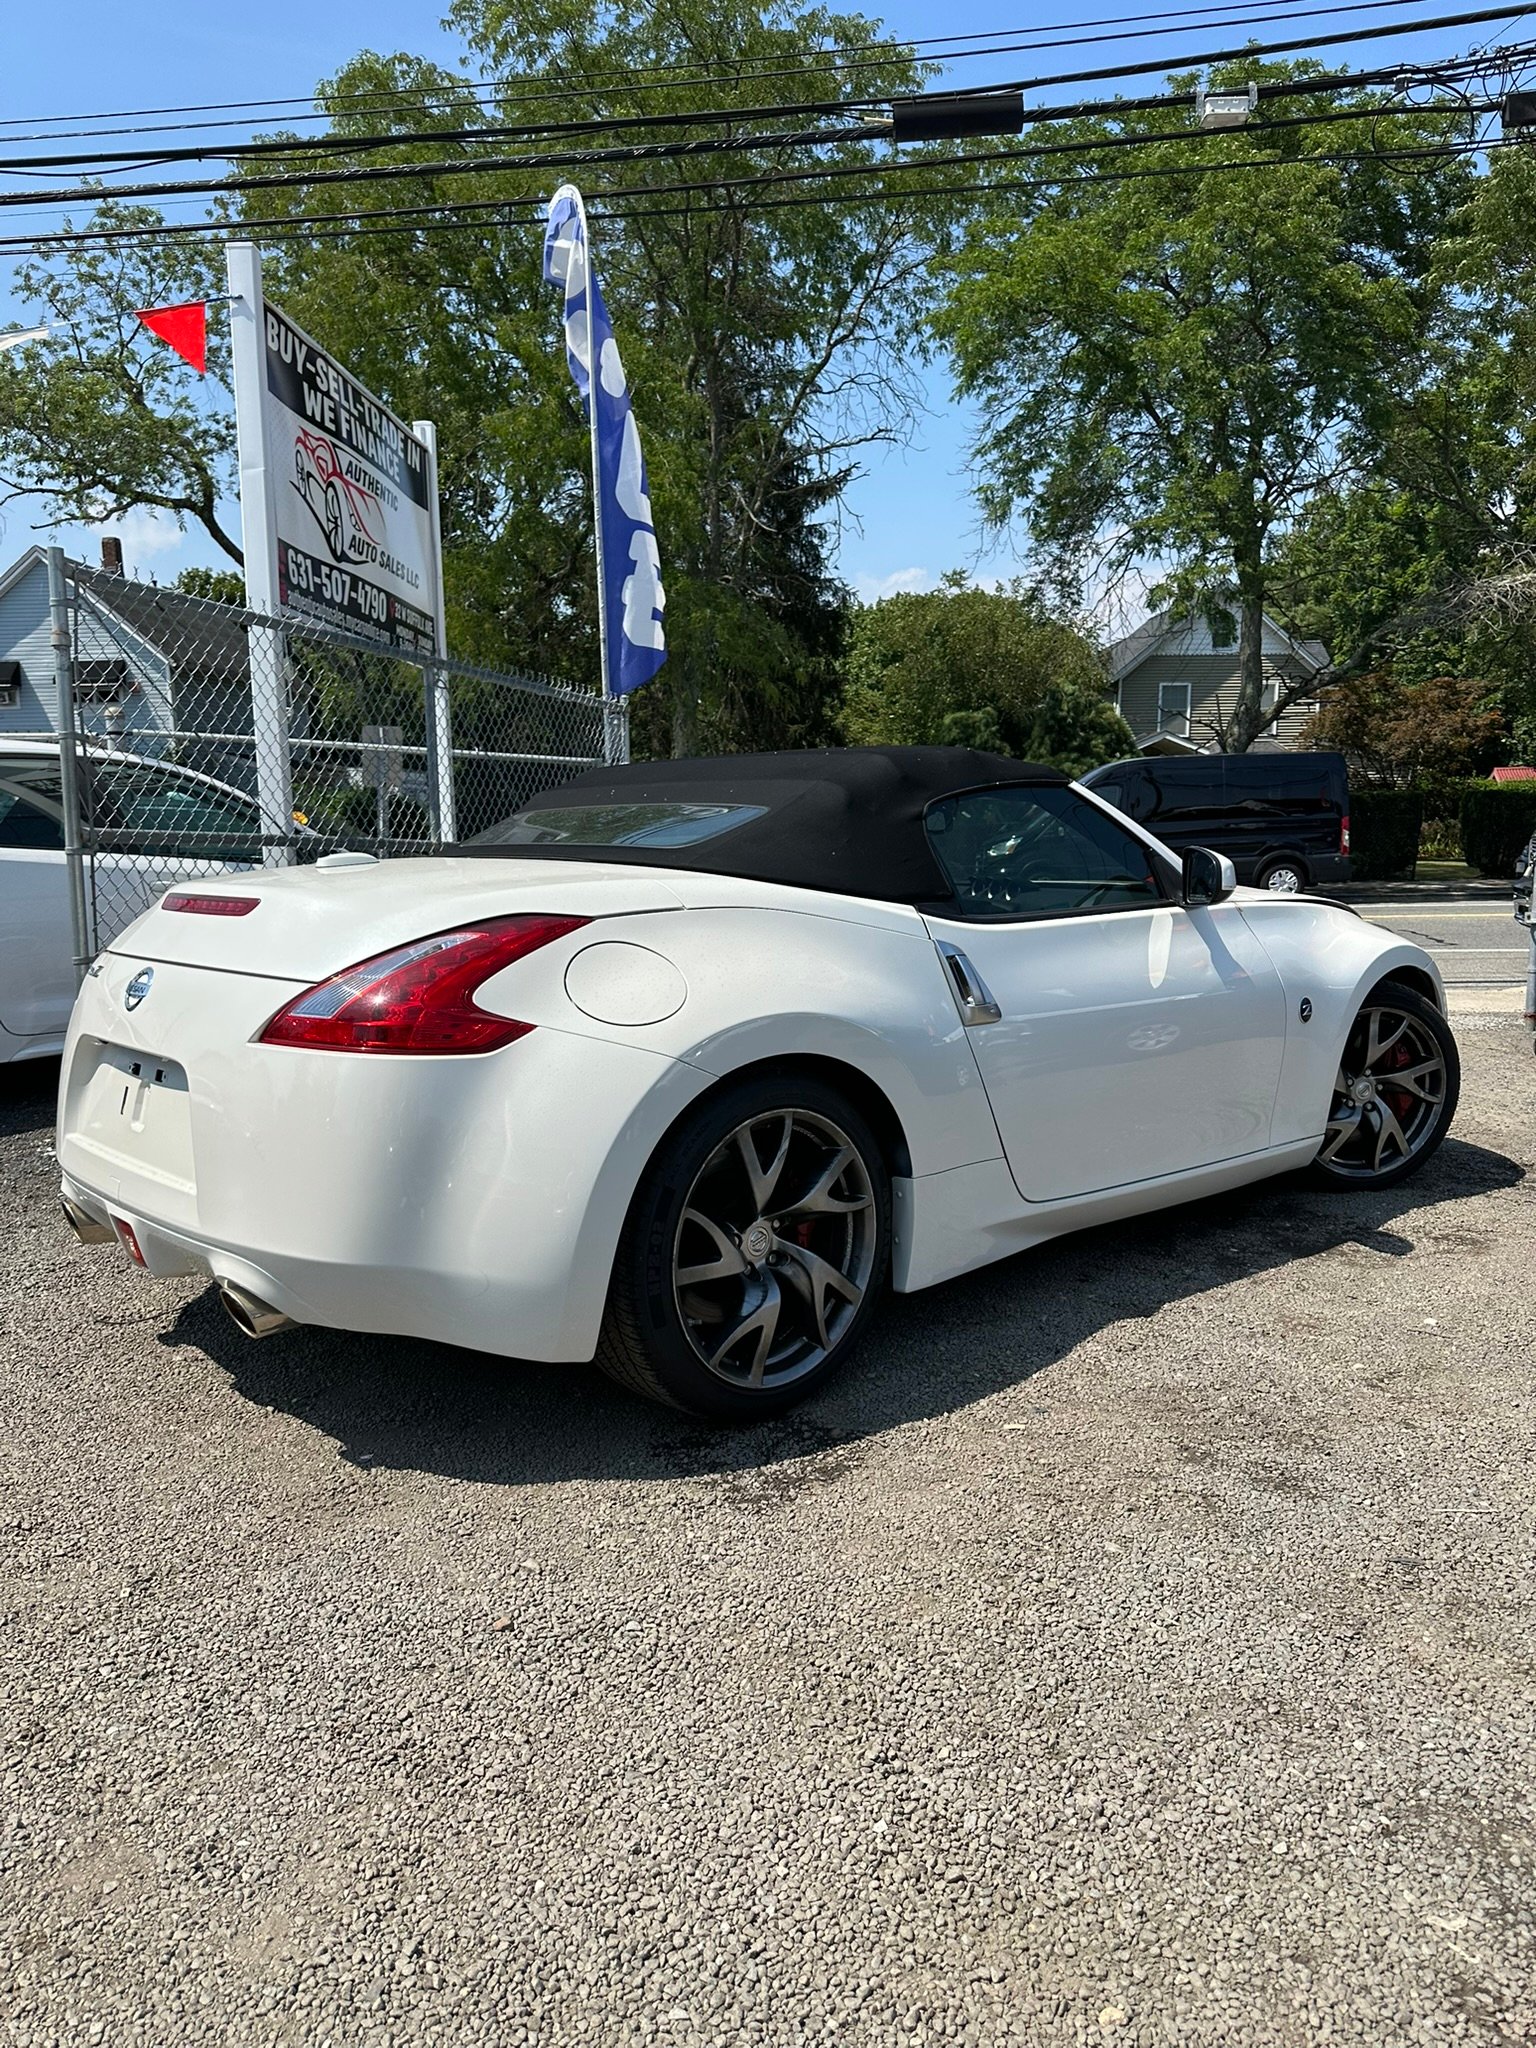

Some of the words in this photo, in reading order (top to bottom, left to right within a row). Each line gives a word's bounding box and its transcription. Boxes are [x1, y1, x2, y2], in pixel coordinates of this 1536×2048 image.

[303, 382, 336, 432] WE
[340, 408, 400, 483] FINANCE
[407, 439, 420, 473] IN
[345, 460, 399, 512] AUTHENTIC
[288, 549, 387, 622] 631-507-4790
[348, 535, 377, 563] AUTO
[379, 551, 405, 580] SALES
[406, 568, 420, 589] LLC
